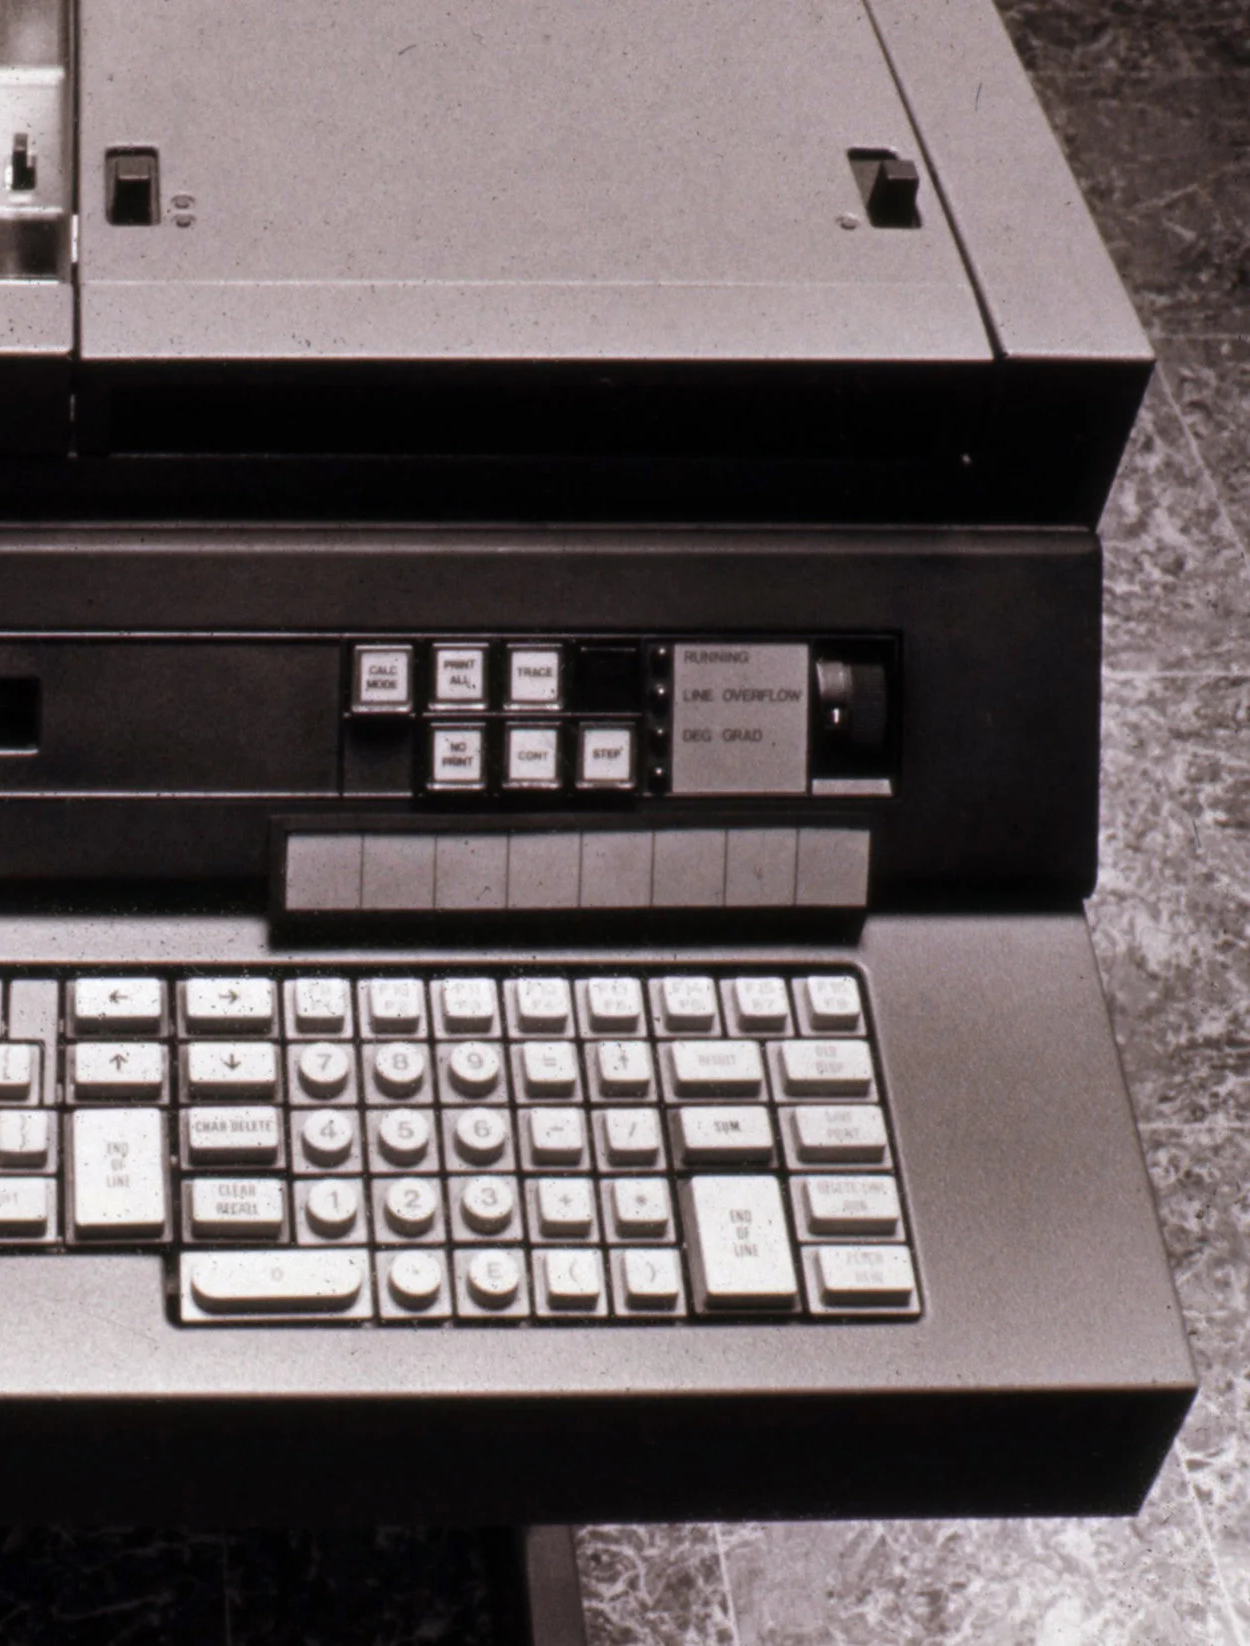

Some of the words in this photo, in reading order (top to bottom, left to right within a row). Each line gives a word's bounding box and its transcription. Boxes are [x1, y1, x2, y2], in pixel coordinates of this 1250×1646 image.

[684, 651, 749, 664] RUNNING
[369, 666, 397, 675] CALC
[443, 660, 475, 670] PRINT
[518, 668, 552, 677] TRACE
[366, 680, 397, 690] MODE
[683, 689, 713, 702] LINE
[722, 689, 801, 702] OVERFLOW
[682, 729, 712, 742] DEG
[722, 729, 763, 742] GRAD
[518, 751, 548, 760] CONT
[593, 749, 621, 759] STEP
[442, 757, 472, 767] PRINT
[316, 1053, 333, 1072] 7
[391, 1052, 410, 1071] 8
[465, 1052, 485, 1071] 9
[194, 1120, 227, 1133] CHAR
[231, 1119, 272, 1133] DELETE
[318, 1121, 339, 1141] 4
[396, 1121, 415, 1141] 5
[472, 1120, 491, 1140] 6
[713, 1120, 741, 1133] SUM
[106, 1174, 130, 1188] LINE
[217, 1184, 256, 1198] CLEAR
[405, 1188, 421, 1208] 2
[480, 1187, 498, 1207] 3
[330, 1190, 340, 1209] 1
[216, 1202, 259, 1216] RECALL
[729, 1209, 753, 1223] END
[733, 1243, 759, 1258] LINE
